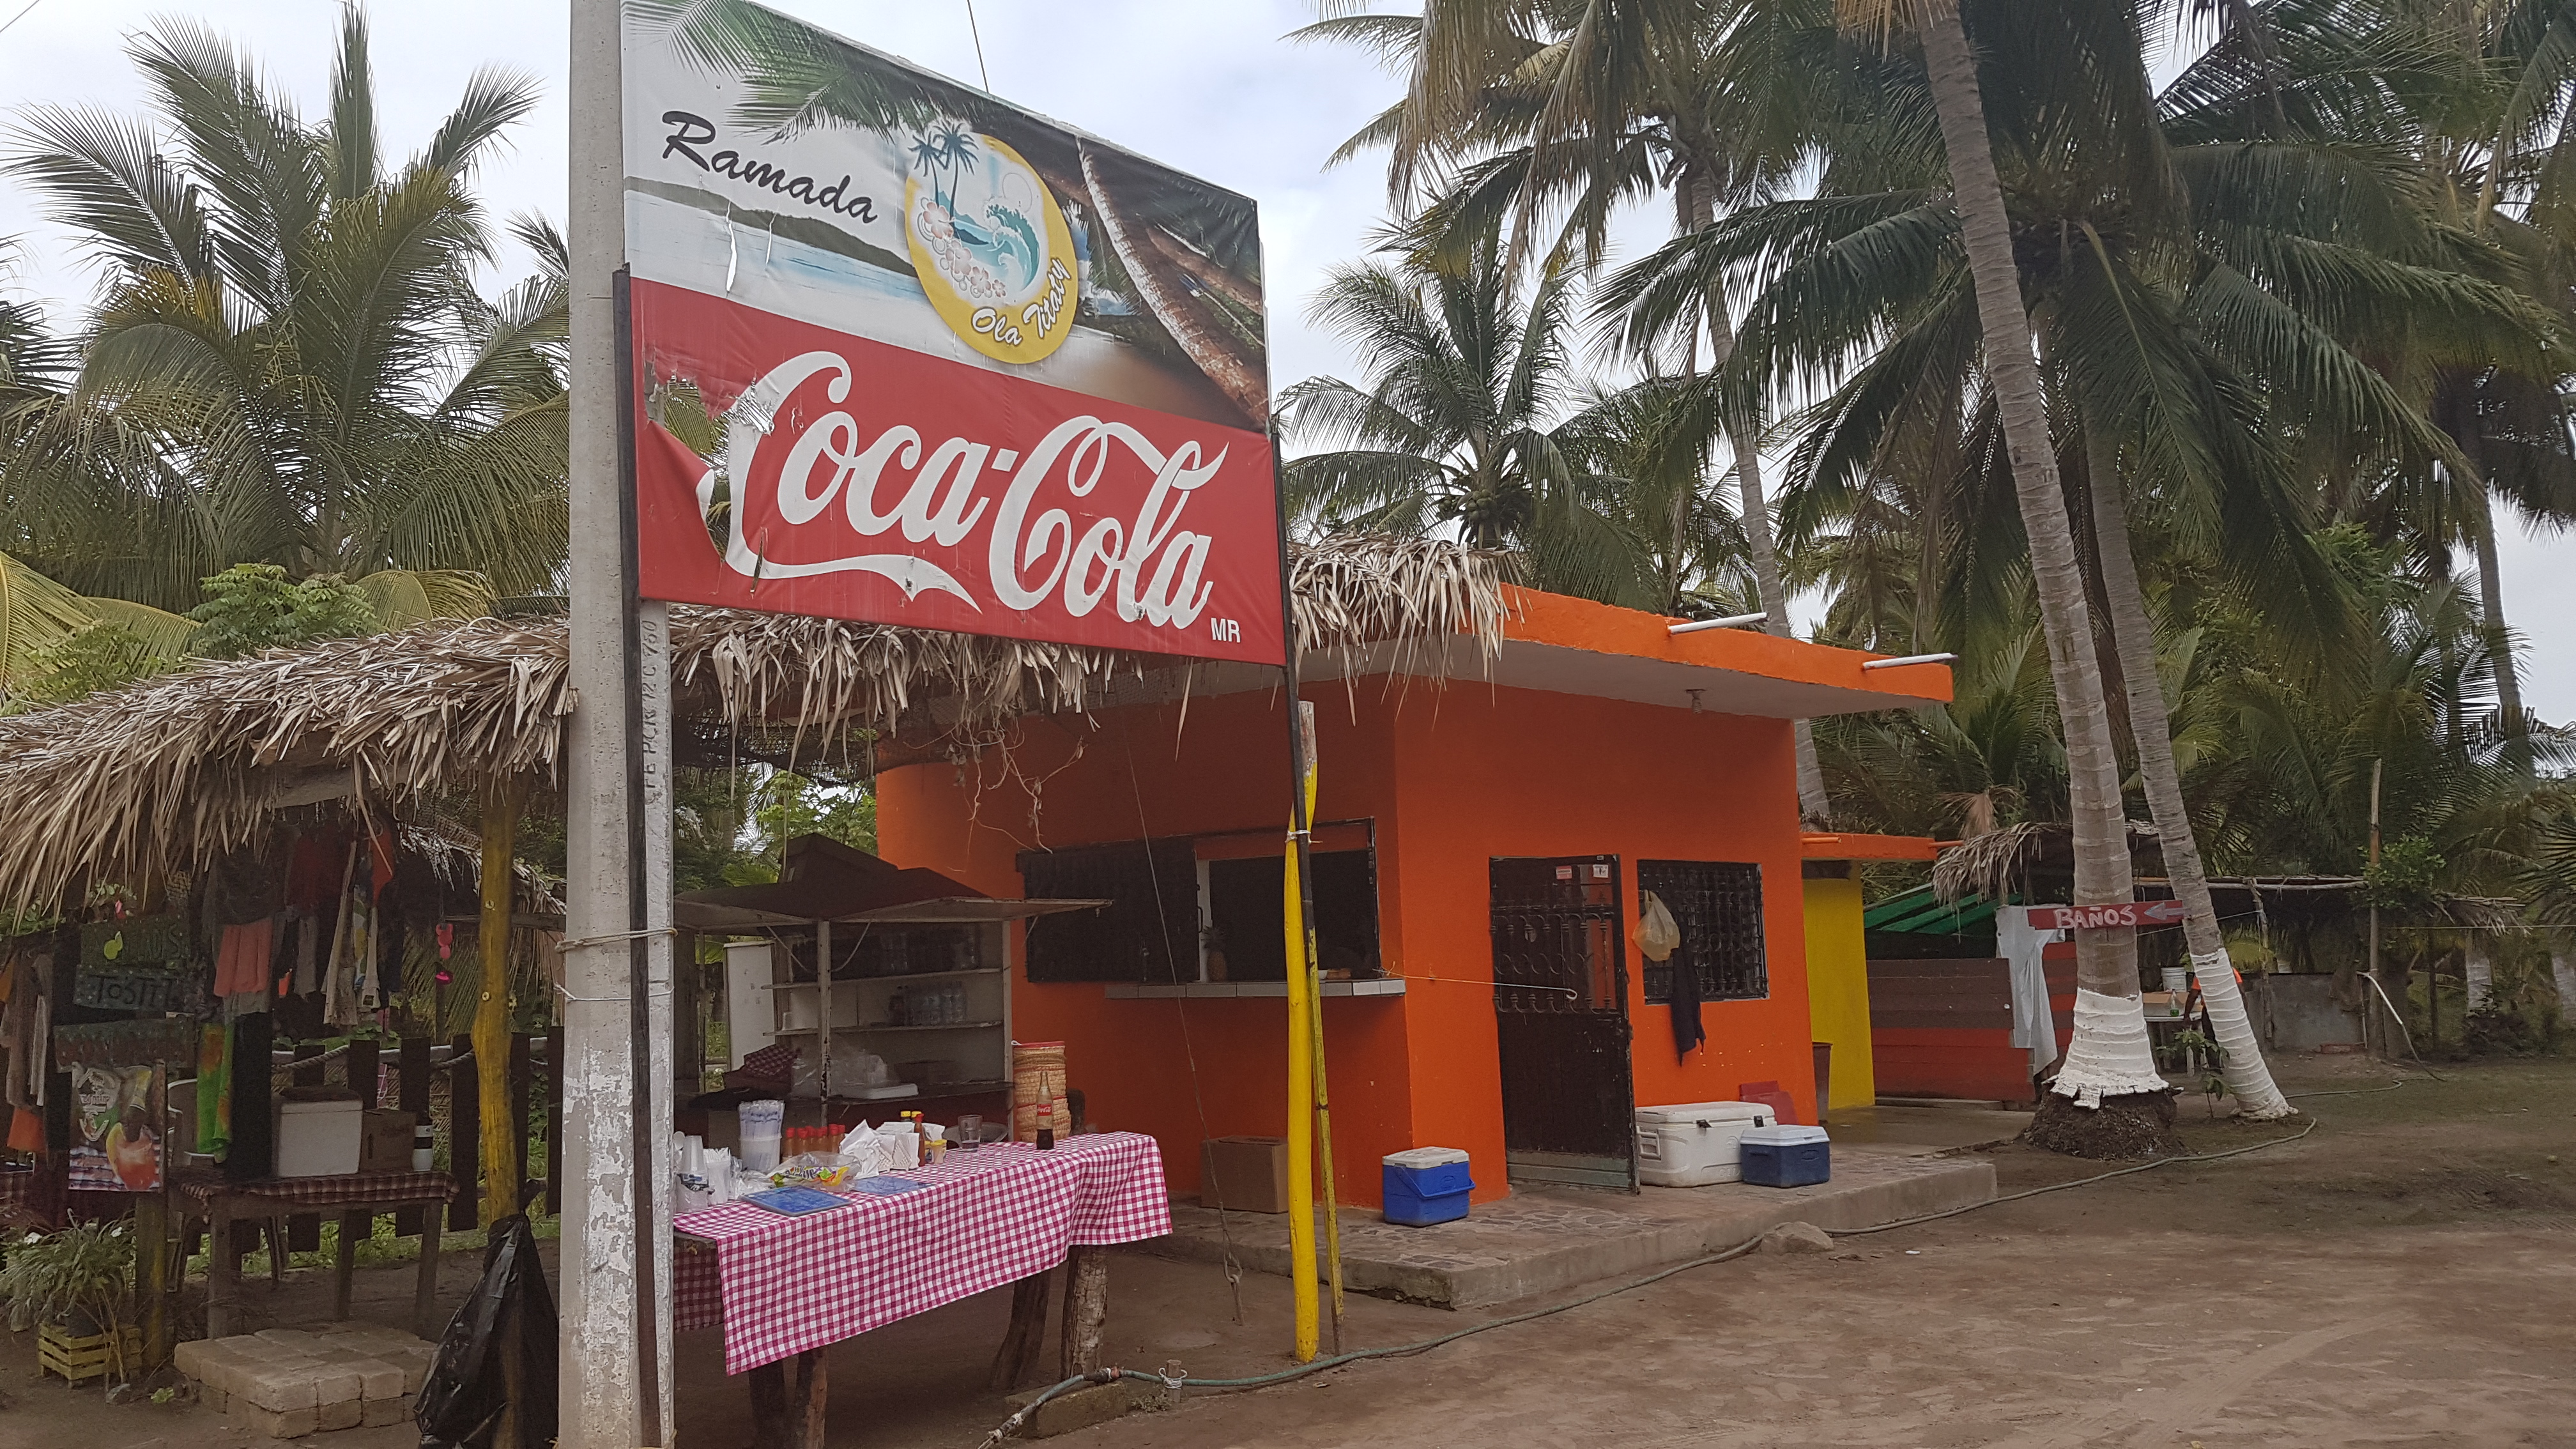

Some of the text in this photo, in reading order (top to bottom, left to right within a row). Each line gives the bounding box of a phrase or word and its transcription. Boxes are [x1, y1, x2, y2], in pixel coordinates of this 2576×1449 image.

[662, 111, 878, 224] Ramada
[971, 307, 1023, 346] Ola
[724, 351, 1229, 630] Coca-Cola
[1210, 617, 1241, 643] MR
[2054, 905, 2137, 928] BAÑOS
